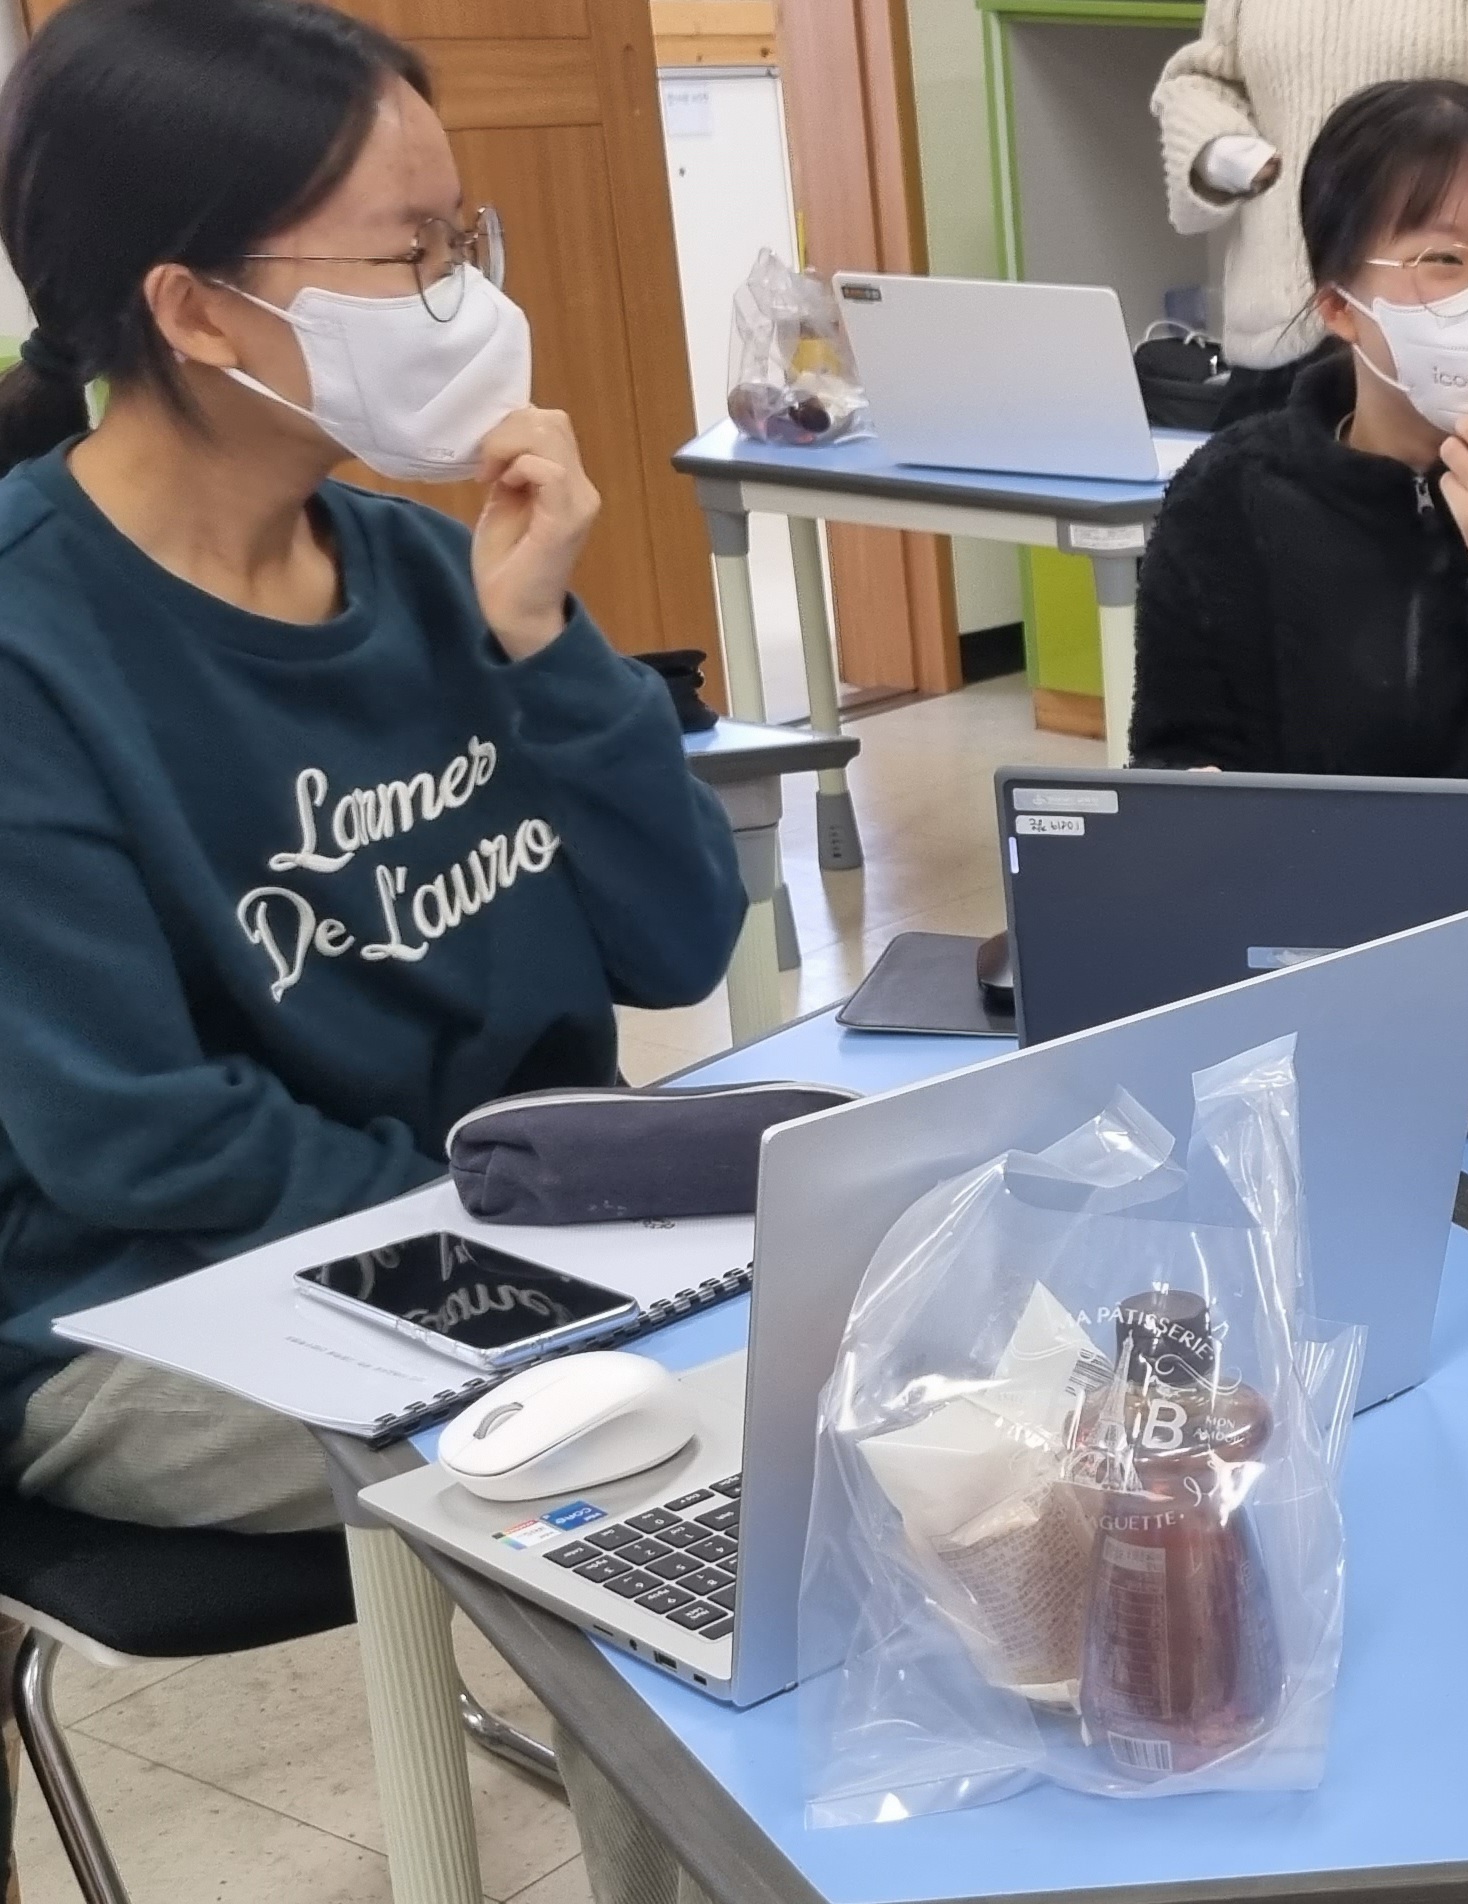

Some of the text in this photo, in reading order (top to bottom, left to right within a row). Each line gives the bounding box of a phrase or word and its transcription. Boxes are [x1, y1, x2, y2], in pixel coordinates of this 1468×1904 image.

[237, 886, 356, 1003] De
[1141, 1398, 1188, 1450] B
[1085, 1510, 1177, 1531] GUETTE
